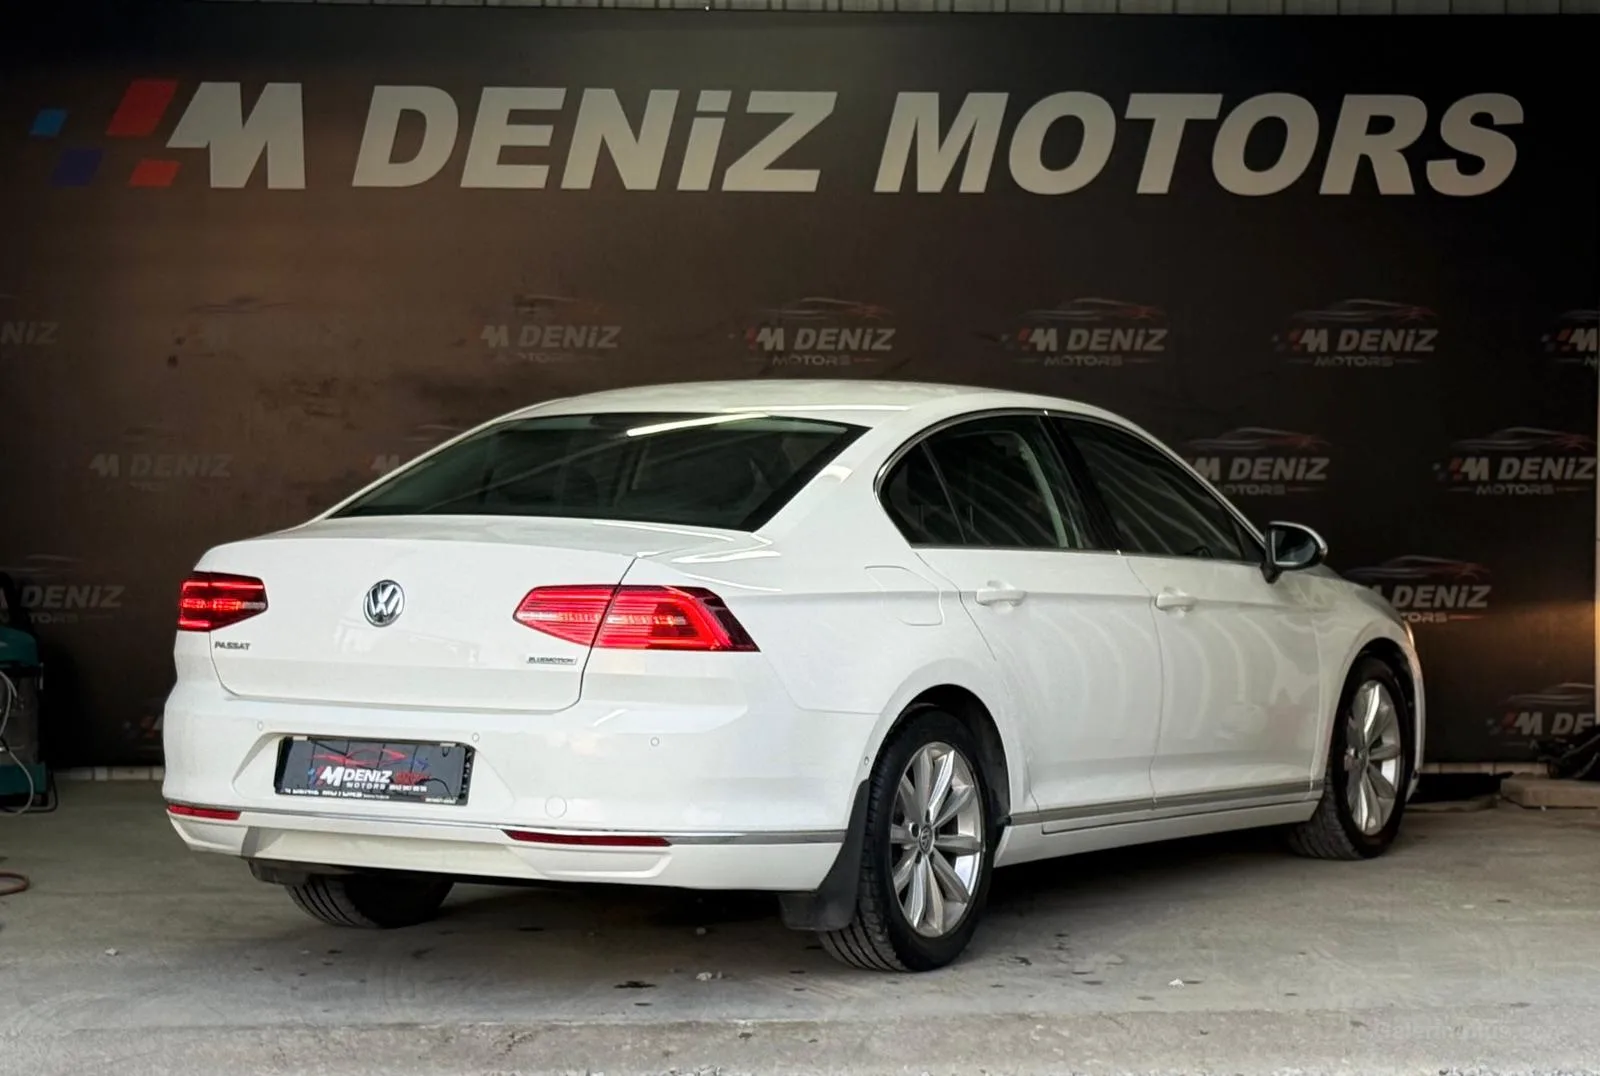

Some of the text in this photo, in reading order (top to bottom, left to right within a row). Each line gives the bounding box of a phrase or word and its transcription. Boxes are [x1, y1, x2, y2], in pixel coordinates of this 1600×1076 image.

[166, 81, 306, 189] M
[874, 91, 1525, 197] MOTORS
[772, 354, 852, 367] MOTORS
[1044, 355, 1124, 368] MOTORS
[1314, 355, 1394, 368] MOTORS
[1222, 483, 1286, 496] OTORS
[1475, 483, 1555, 496] MOTORS
[214, 641, 251, 651] PASSAT
